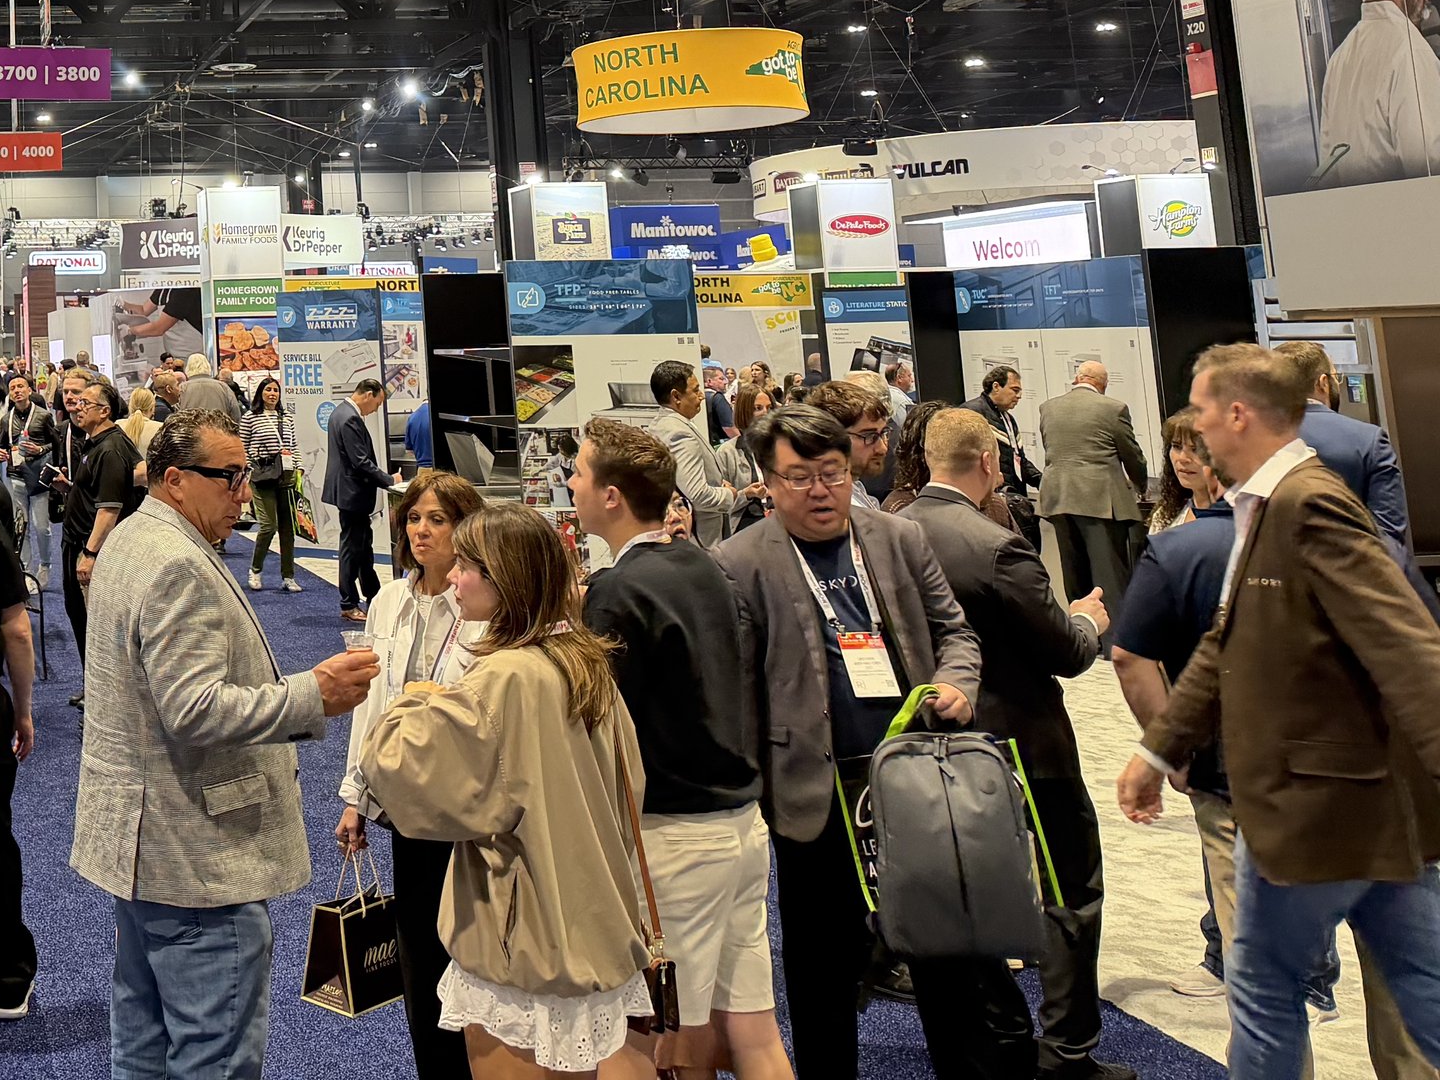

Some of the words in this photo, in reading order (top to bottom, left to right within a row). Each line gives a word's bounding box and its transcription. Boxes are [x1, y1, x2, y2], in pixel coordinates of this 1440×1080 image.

[1186, 21, 1205, 36] X20
[593, 42, 679, 74] NORTH
[56, 66, 101, 82] 3800
[585, 73, 710, 109] CAROLINA
[22, 145, 55, 158] 4000
[158, 228, 195, 245] Keurig
[221, 223, 278, 236] Homegrown
[292, 225, 325, 242] Keurig
[222, 237, 247, 245] FAMILY
[250, 236, 278, 244] FOODS
[217, 286, 279, 295] HOMEGROWN
[216, 297, 247, 306] FAMILY
[307, 320, 357, 330] WARRANTY
[283, 353, 308, 362] SERVICE
[284, 363, 323, 387] FREE
[364, 938, 398, 968] mae
